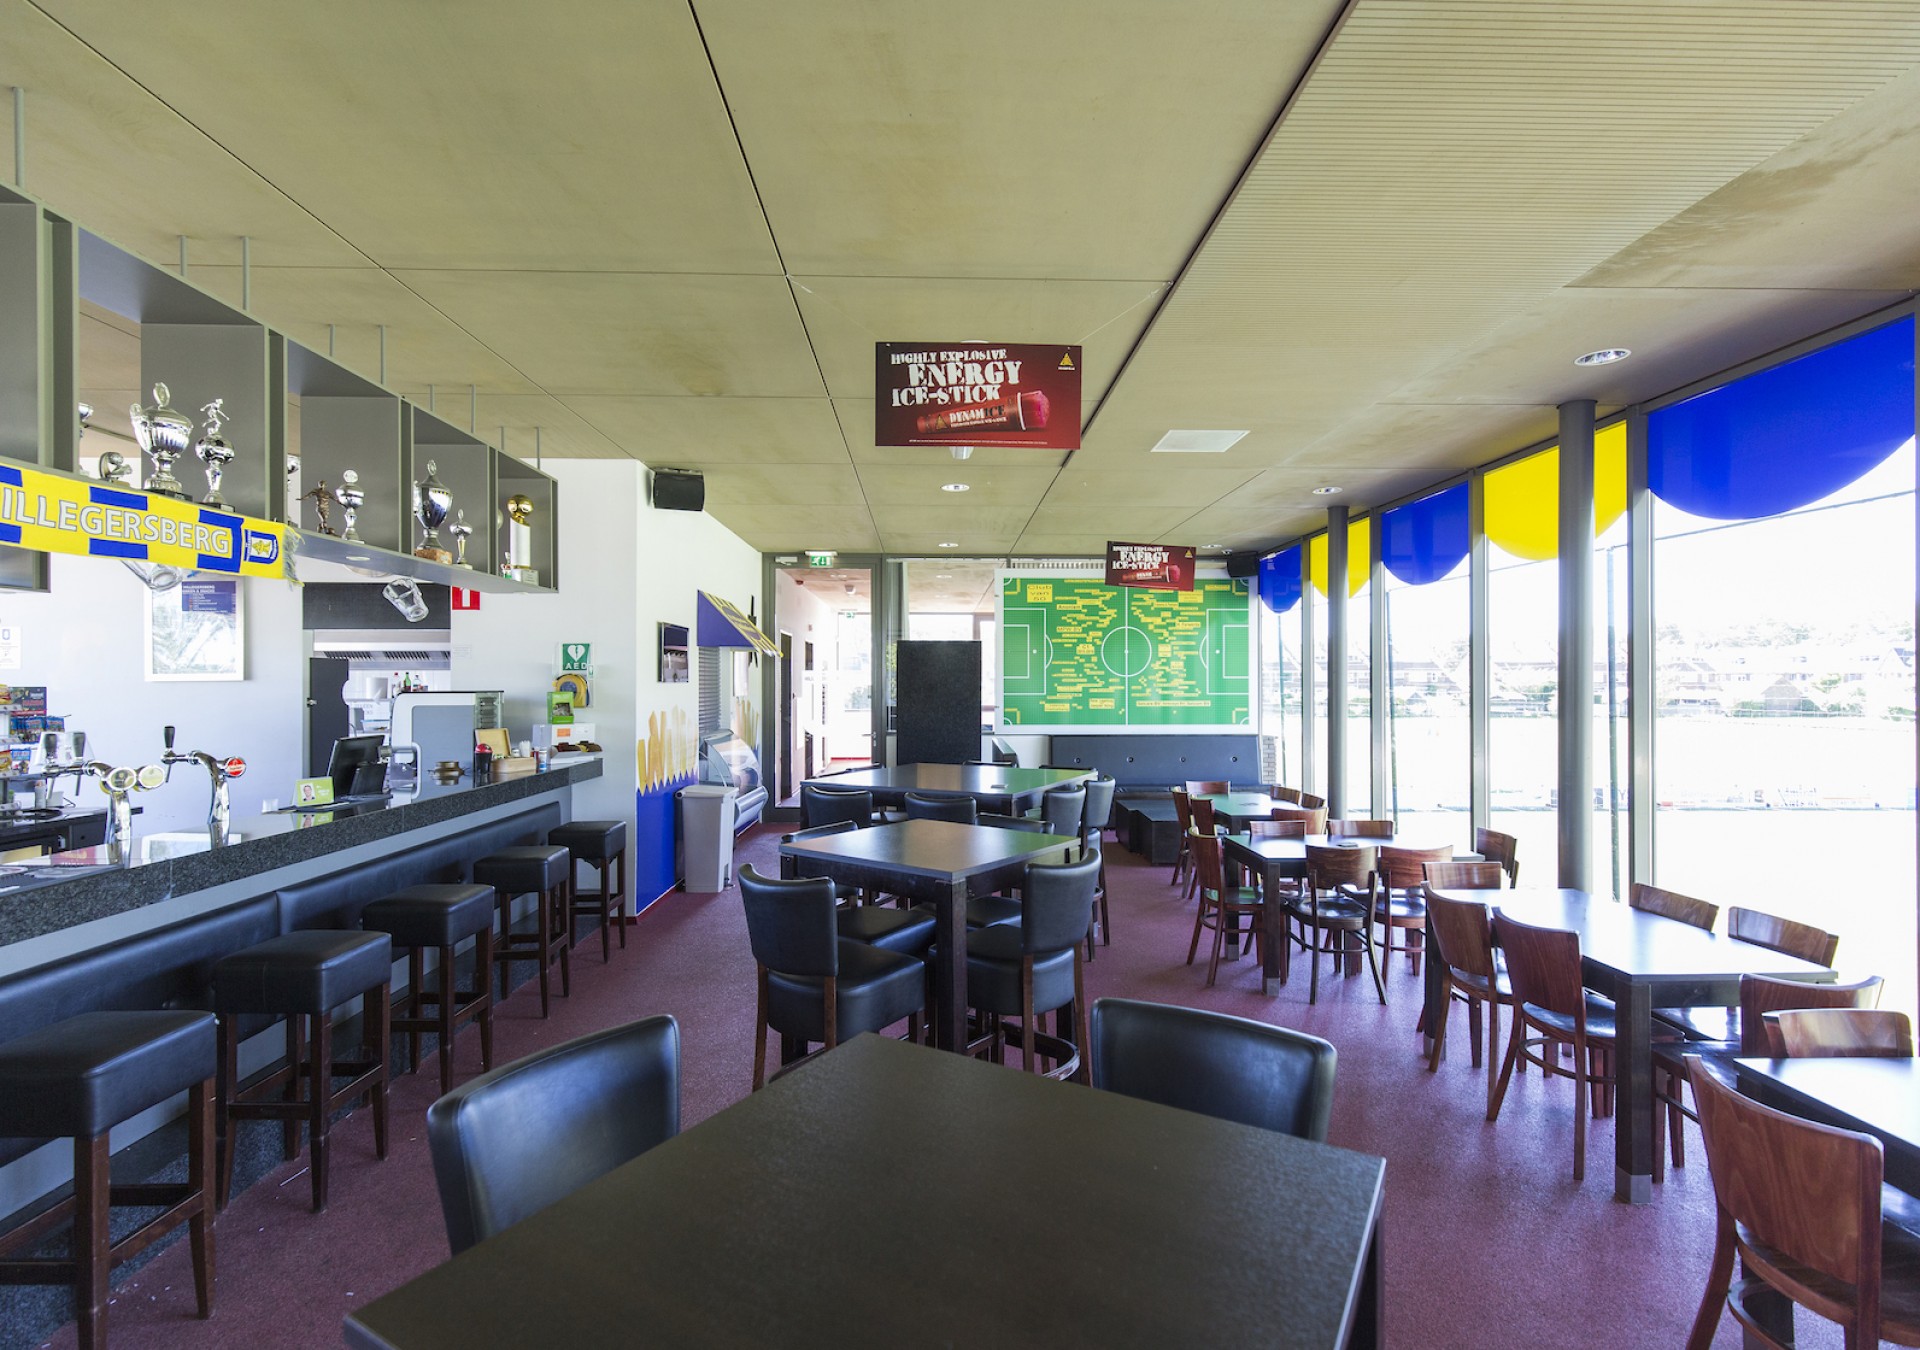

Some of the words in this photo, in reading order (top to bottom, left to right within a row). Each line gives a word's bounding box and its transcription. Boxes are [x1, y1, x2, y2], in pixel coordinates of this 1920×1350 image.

[891, 352, 938, 365] HIGHLY
[940, 349, 1007, 363] EXPLOSIVE
[909, 361, 1022, 387] ENERGY
[892, 384, 1001, 407] ICE-STICK
[1120, 551, 1169, 563] ENERGY
[1112, 560, 1159, 570] ICE-STICK
[565, 662, 587, 670] AED
